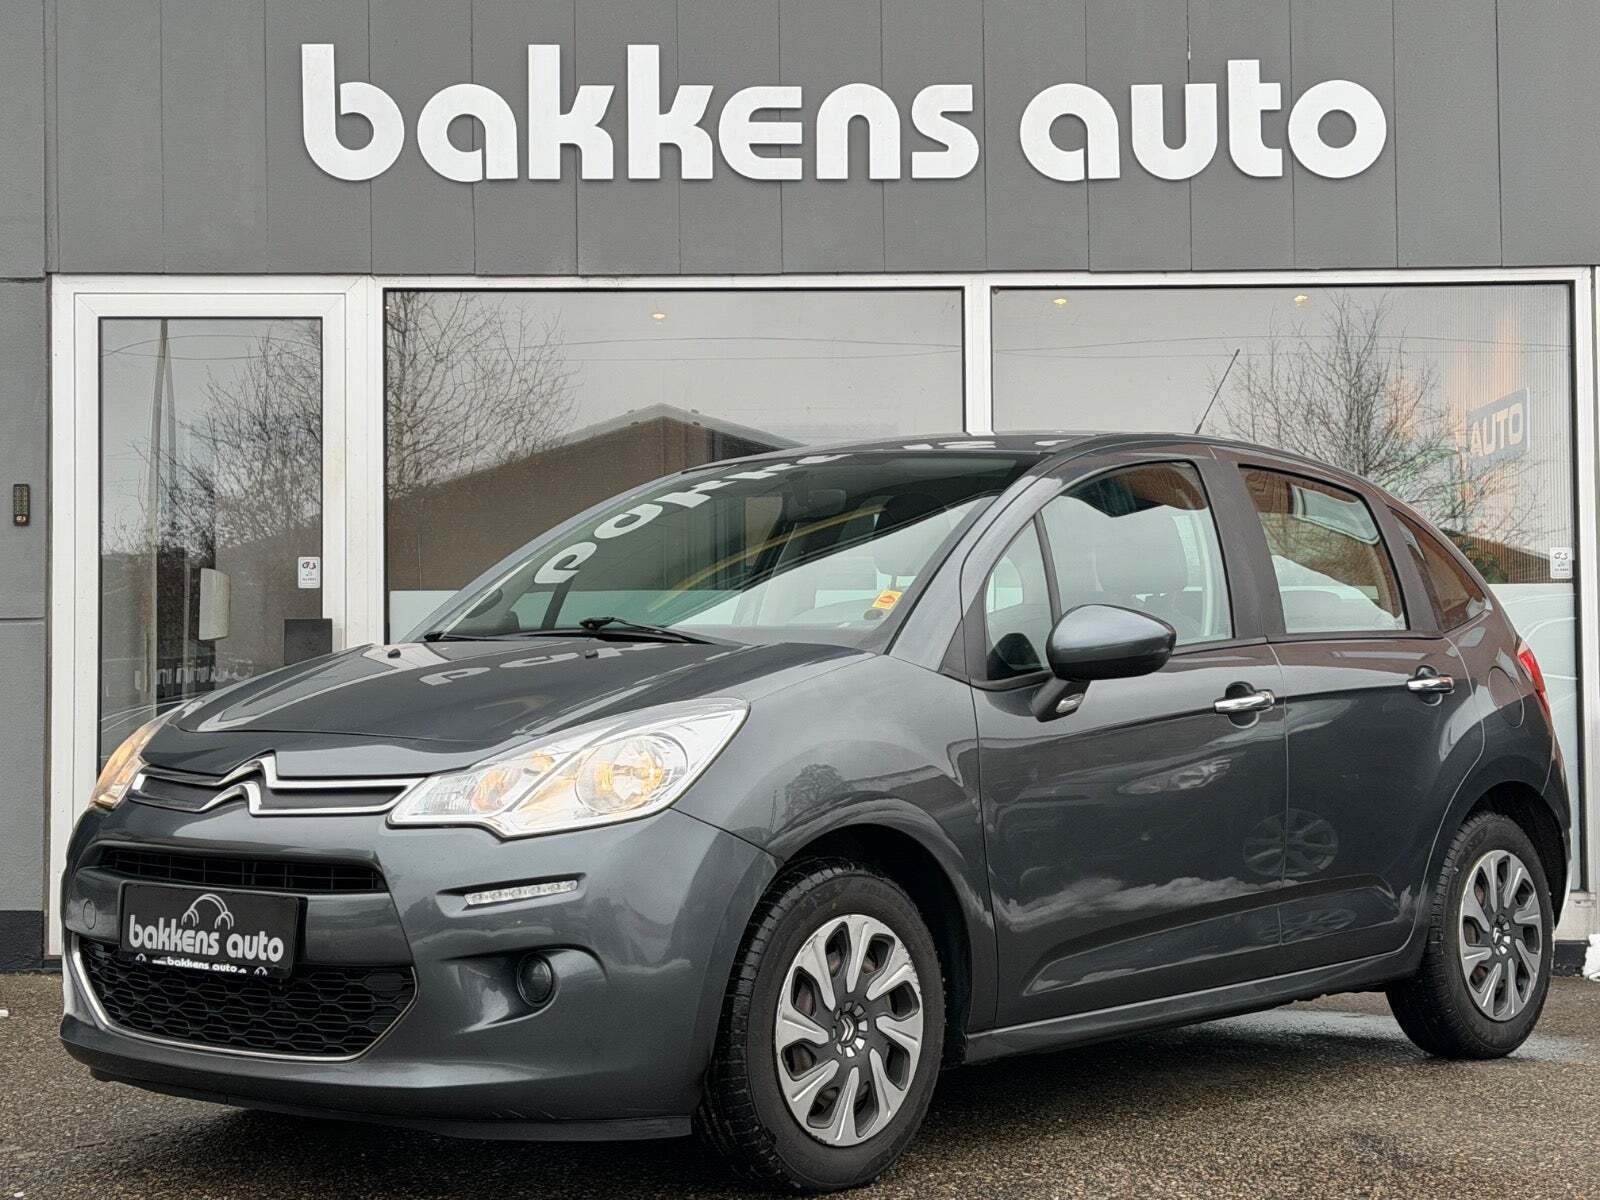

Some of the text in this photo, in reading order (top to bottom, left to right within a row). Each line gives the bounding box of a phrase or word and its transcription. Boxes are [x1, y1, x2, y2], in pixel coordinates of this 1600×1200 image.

[301, 43, 1387, 182] bakkens auto
[1470, 402, 1524, 457] AUTO
[129, 914, 284, 962] bakkens auto
